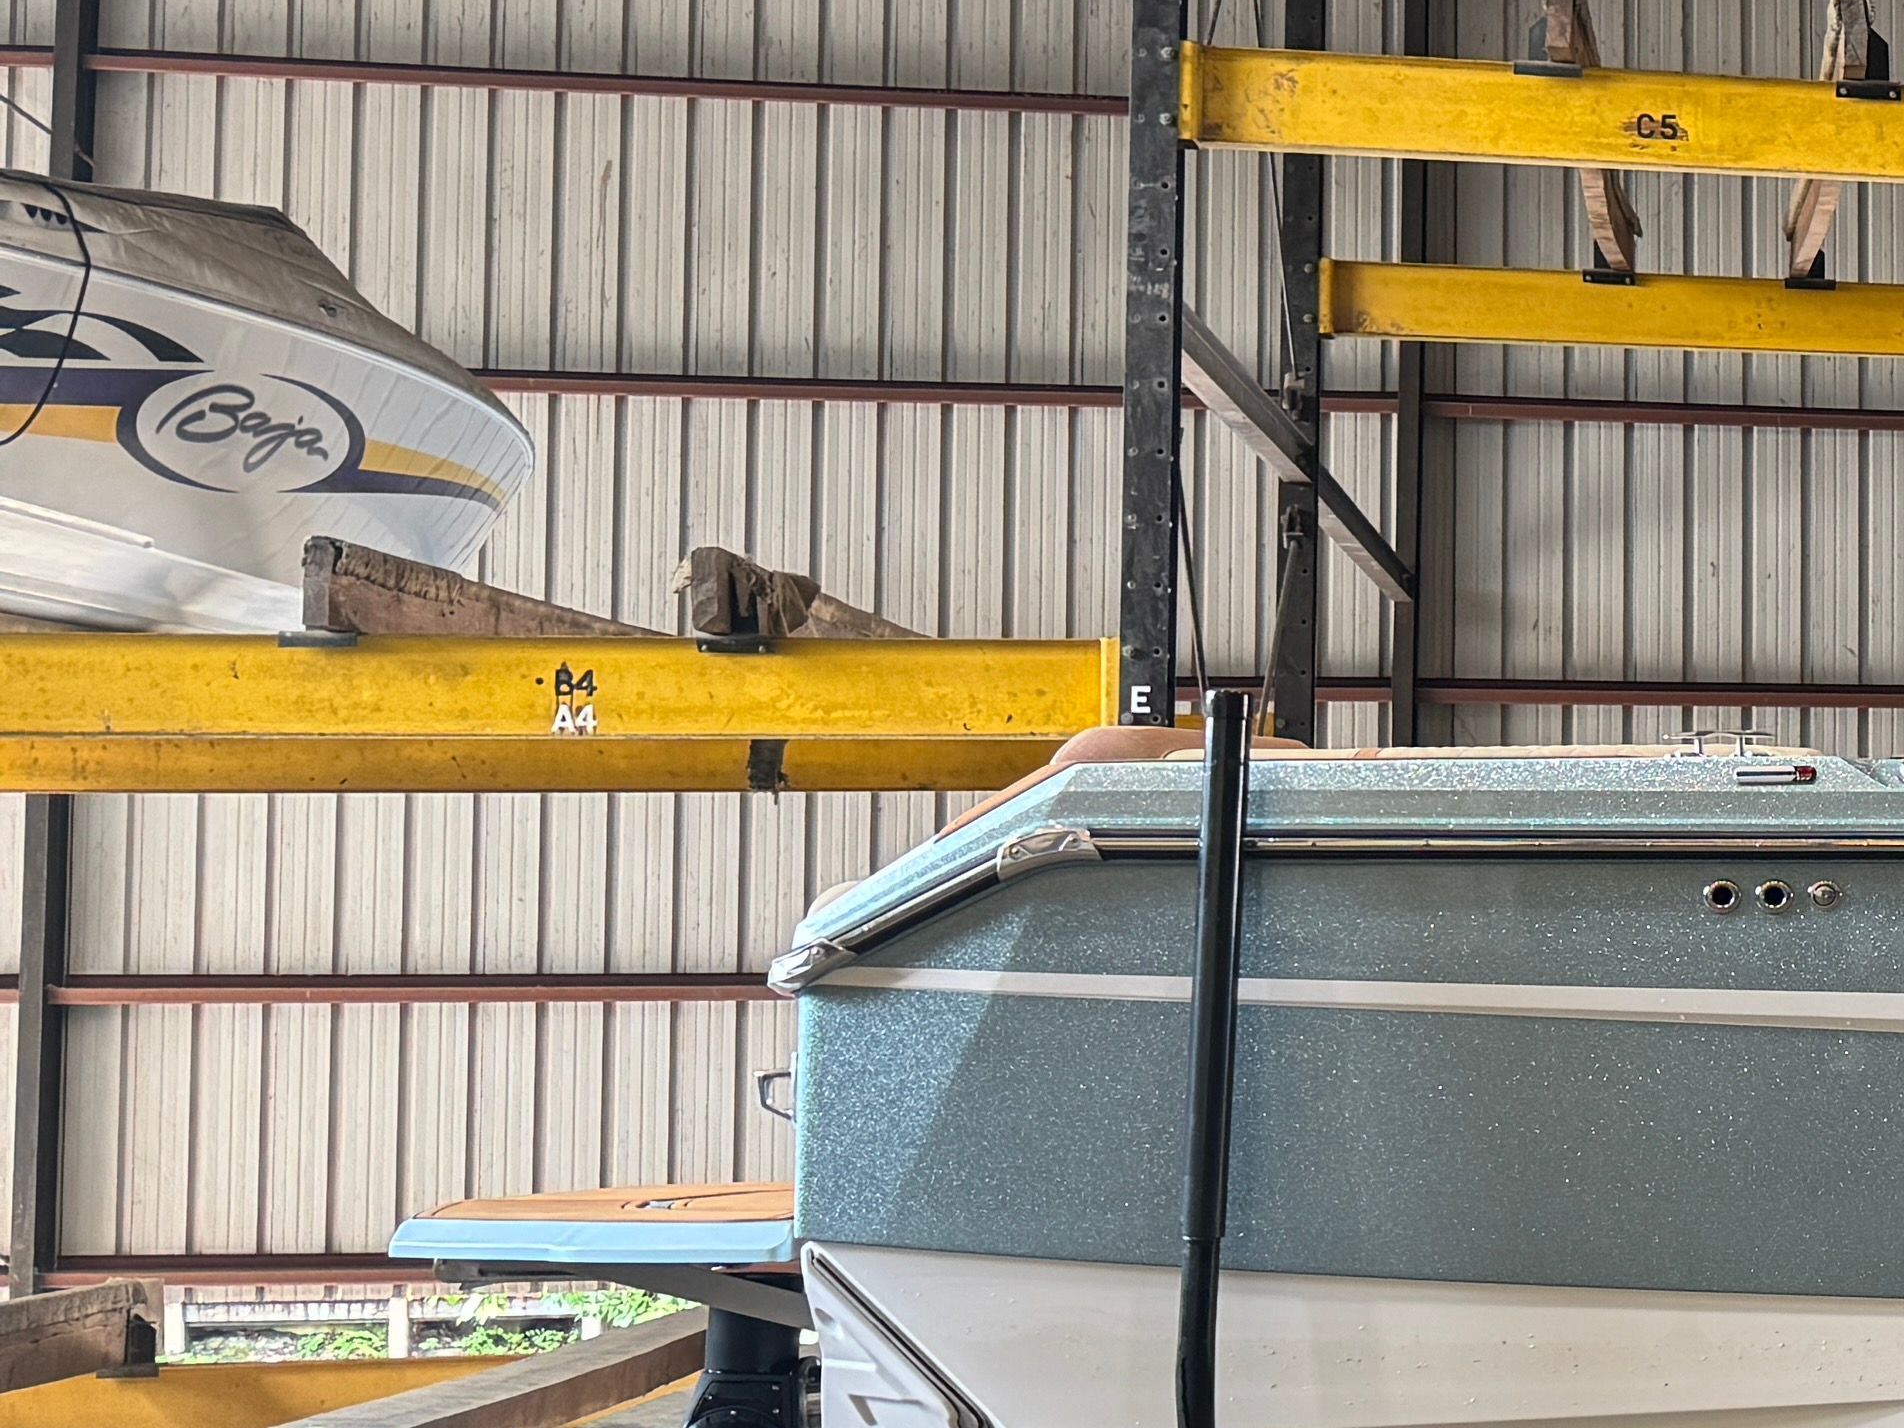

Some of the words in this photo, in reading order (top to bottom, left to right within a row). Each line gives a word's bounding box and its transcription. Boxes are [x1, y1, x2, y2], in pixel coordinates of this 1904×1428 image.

[1637, 113, 1679, 140] C5
[156, 384, 329, 473] Baja
[555, 668, 598, 697] B4
[1131, 685, 1152, 714] E
[551, 702, 599, 736] A4
